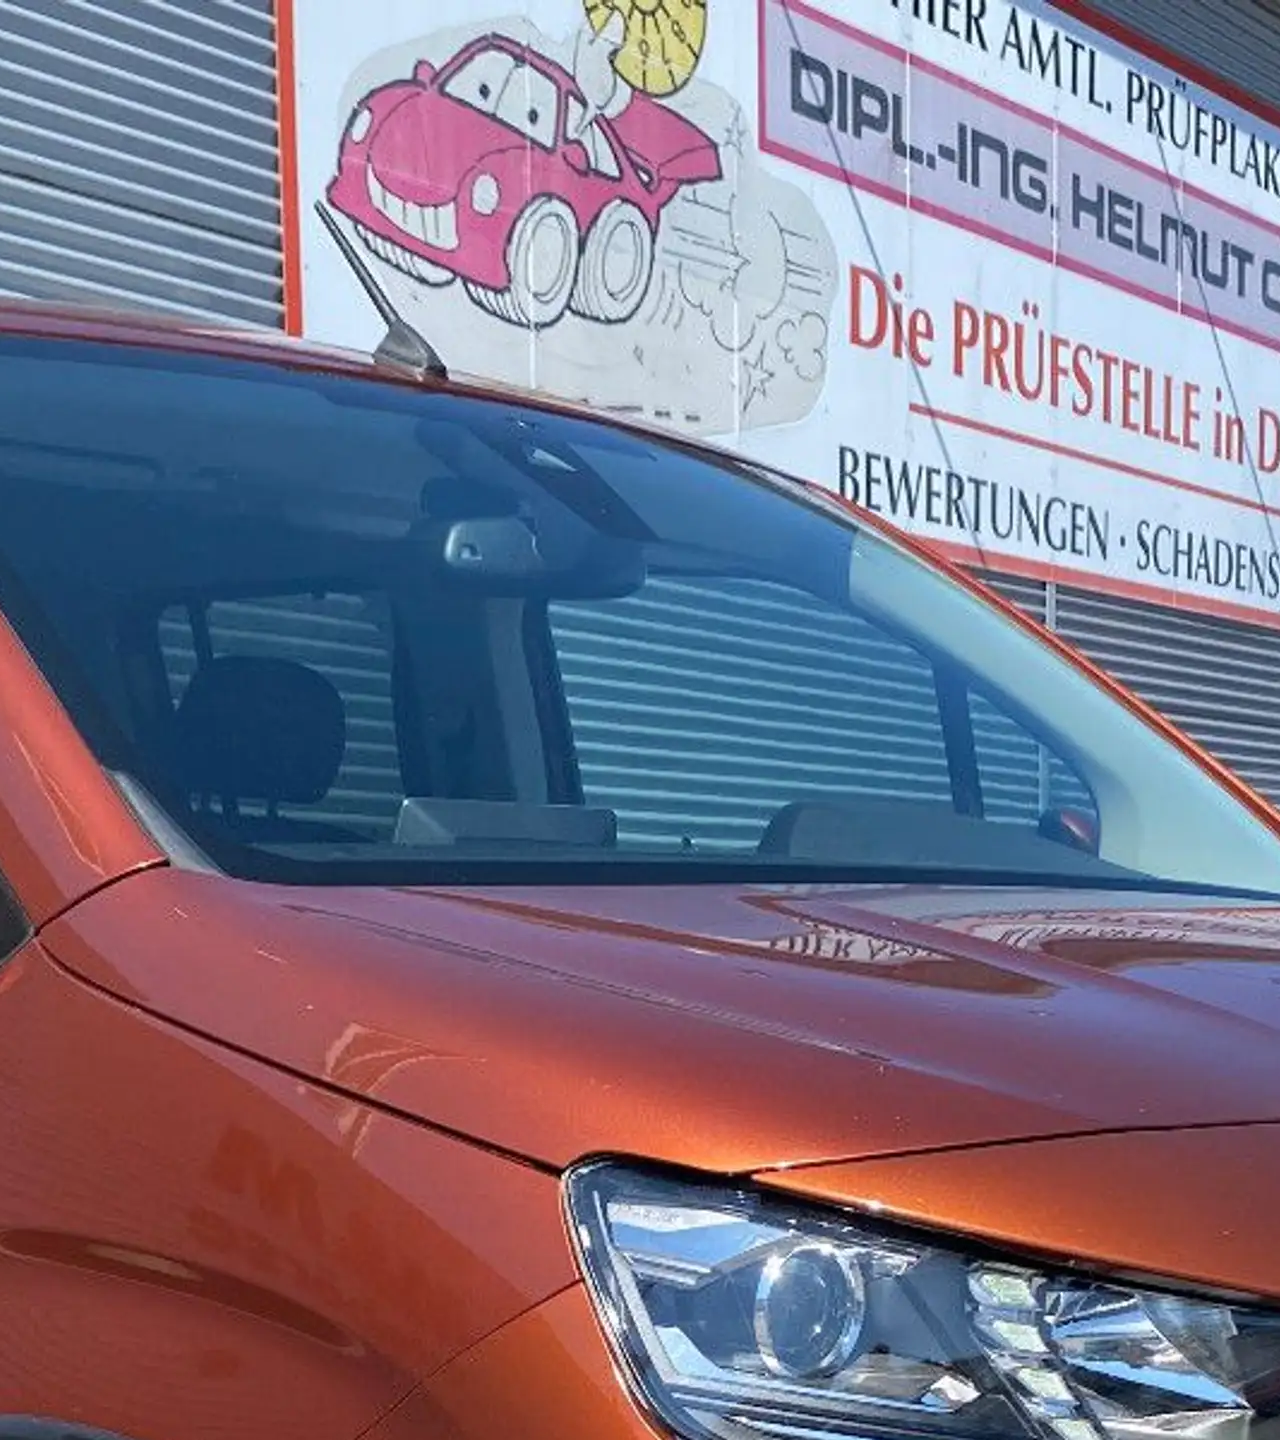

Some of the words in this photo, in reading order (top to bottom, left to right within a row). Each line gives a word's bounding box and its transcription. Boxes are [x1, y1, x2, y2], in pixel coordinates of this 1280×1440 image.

[1000, 6, 1112, 114] AMTL.
[1072, 173, 1254, 298] HELMUT
[850, 263, 934, 367] Die
[953, 299, 1201, 450] PRÜFSTELLE
[1213, 387, 1245, 465] in
[839, 445, 1109, 561] BEWERTUNGEN
